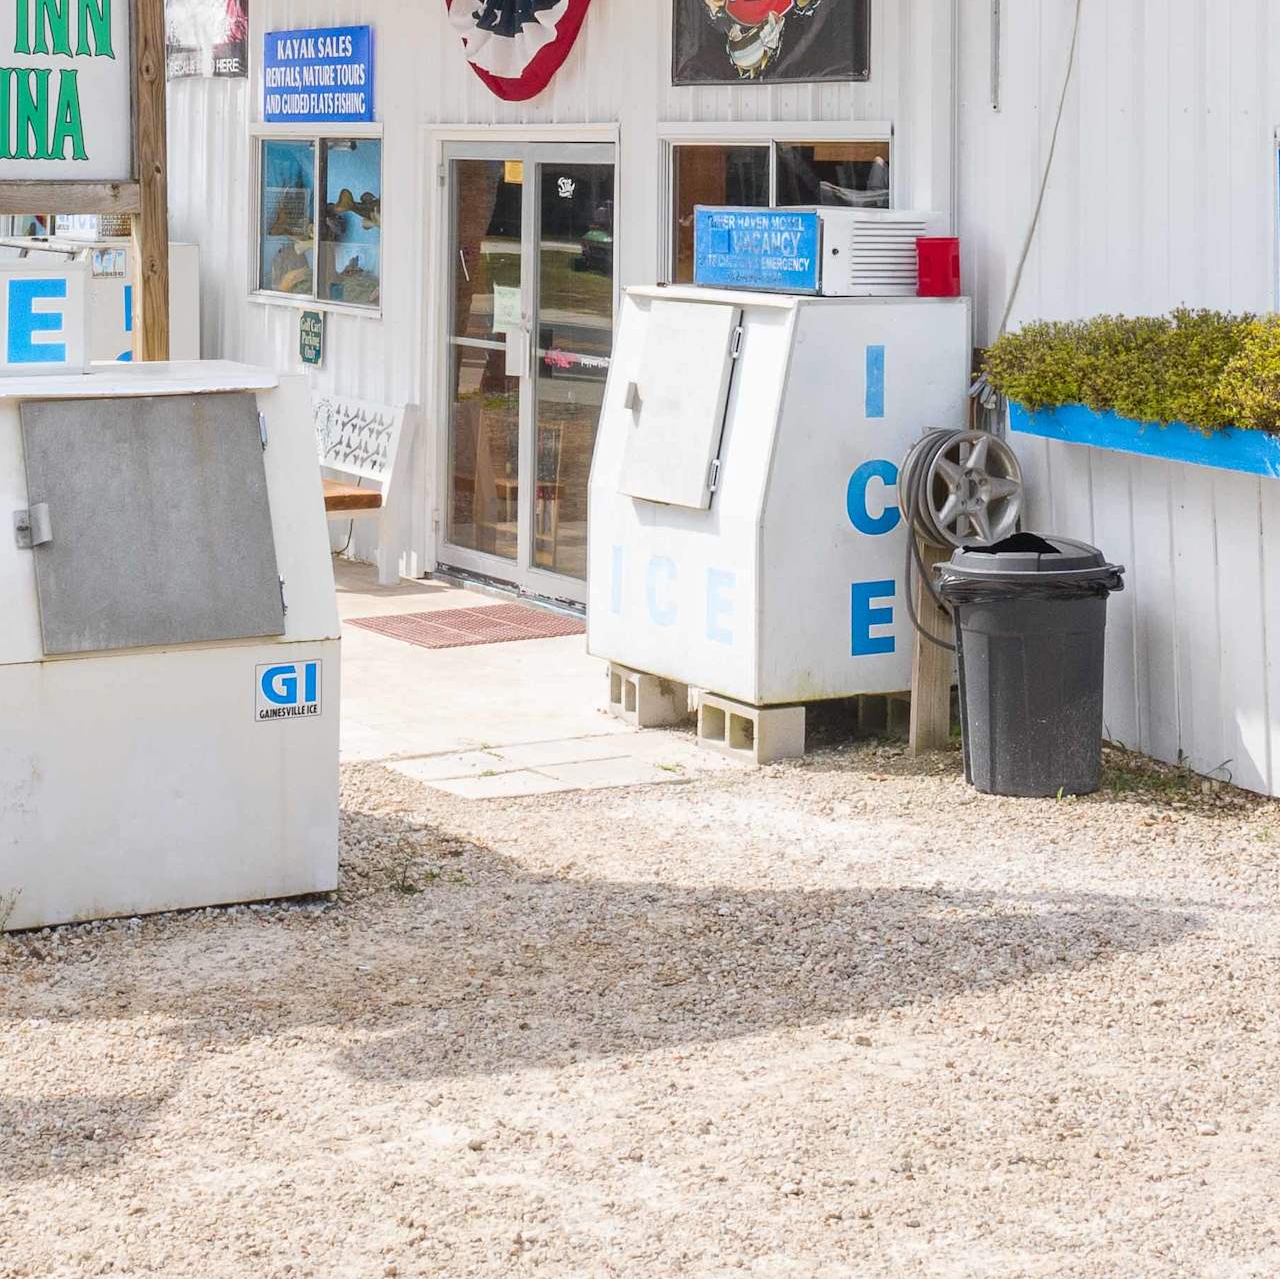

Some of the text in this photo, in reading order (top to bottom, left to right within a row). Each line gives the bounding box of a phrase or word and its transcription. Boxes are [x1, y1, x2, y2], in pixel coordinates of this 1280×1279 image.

[277, 35, 353, 60] KAYAK SALES
[265, 63, 366, 92] RENTALS, NATURE TOURS
[266, 92, 366, 114] AND GUIDED FLATS FISHING
[732, 230, 801, 257] VACANCY
[847, 344, 900, 657] ICE
[610, 544, 736, 646] ICE
[261, 663, 316, 704] GI
[260, 704, 317, 719] GAINESVILLE ICE
